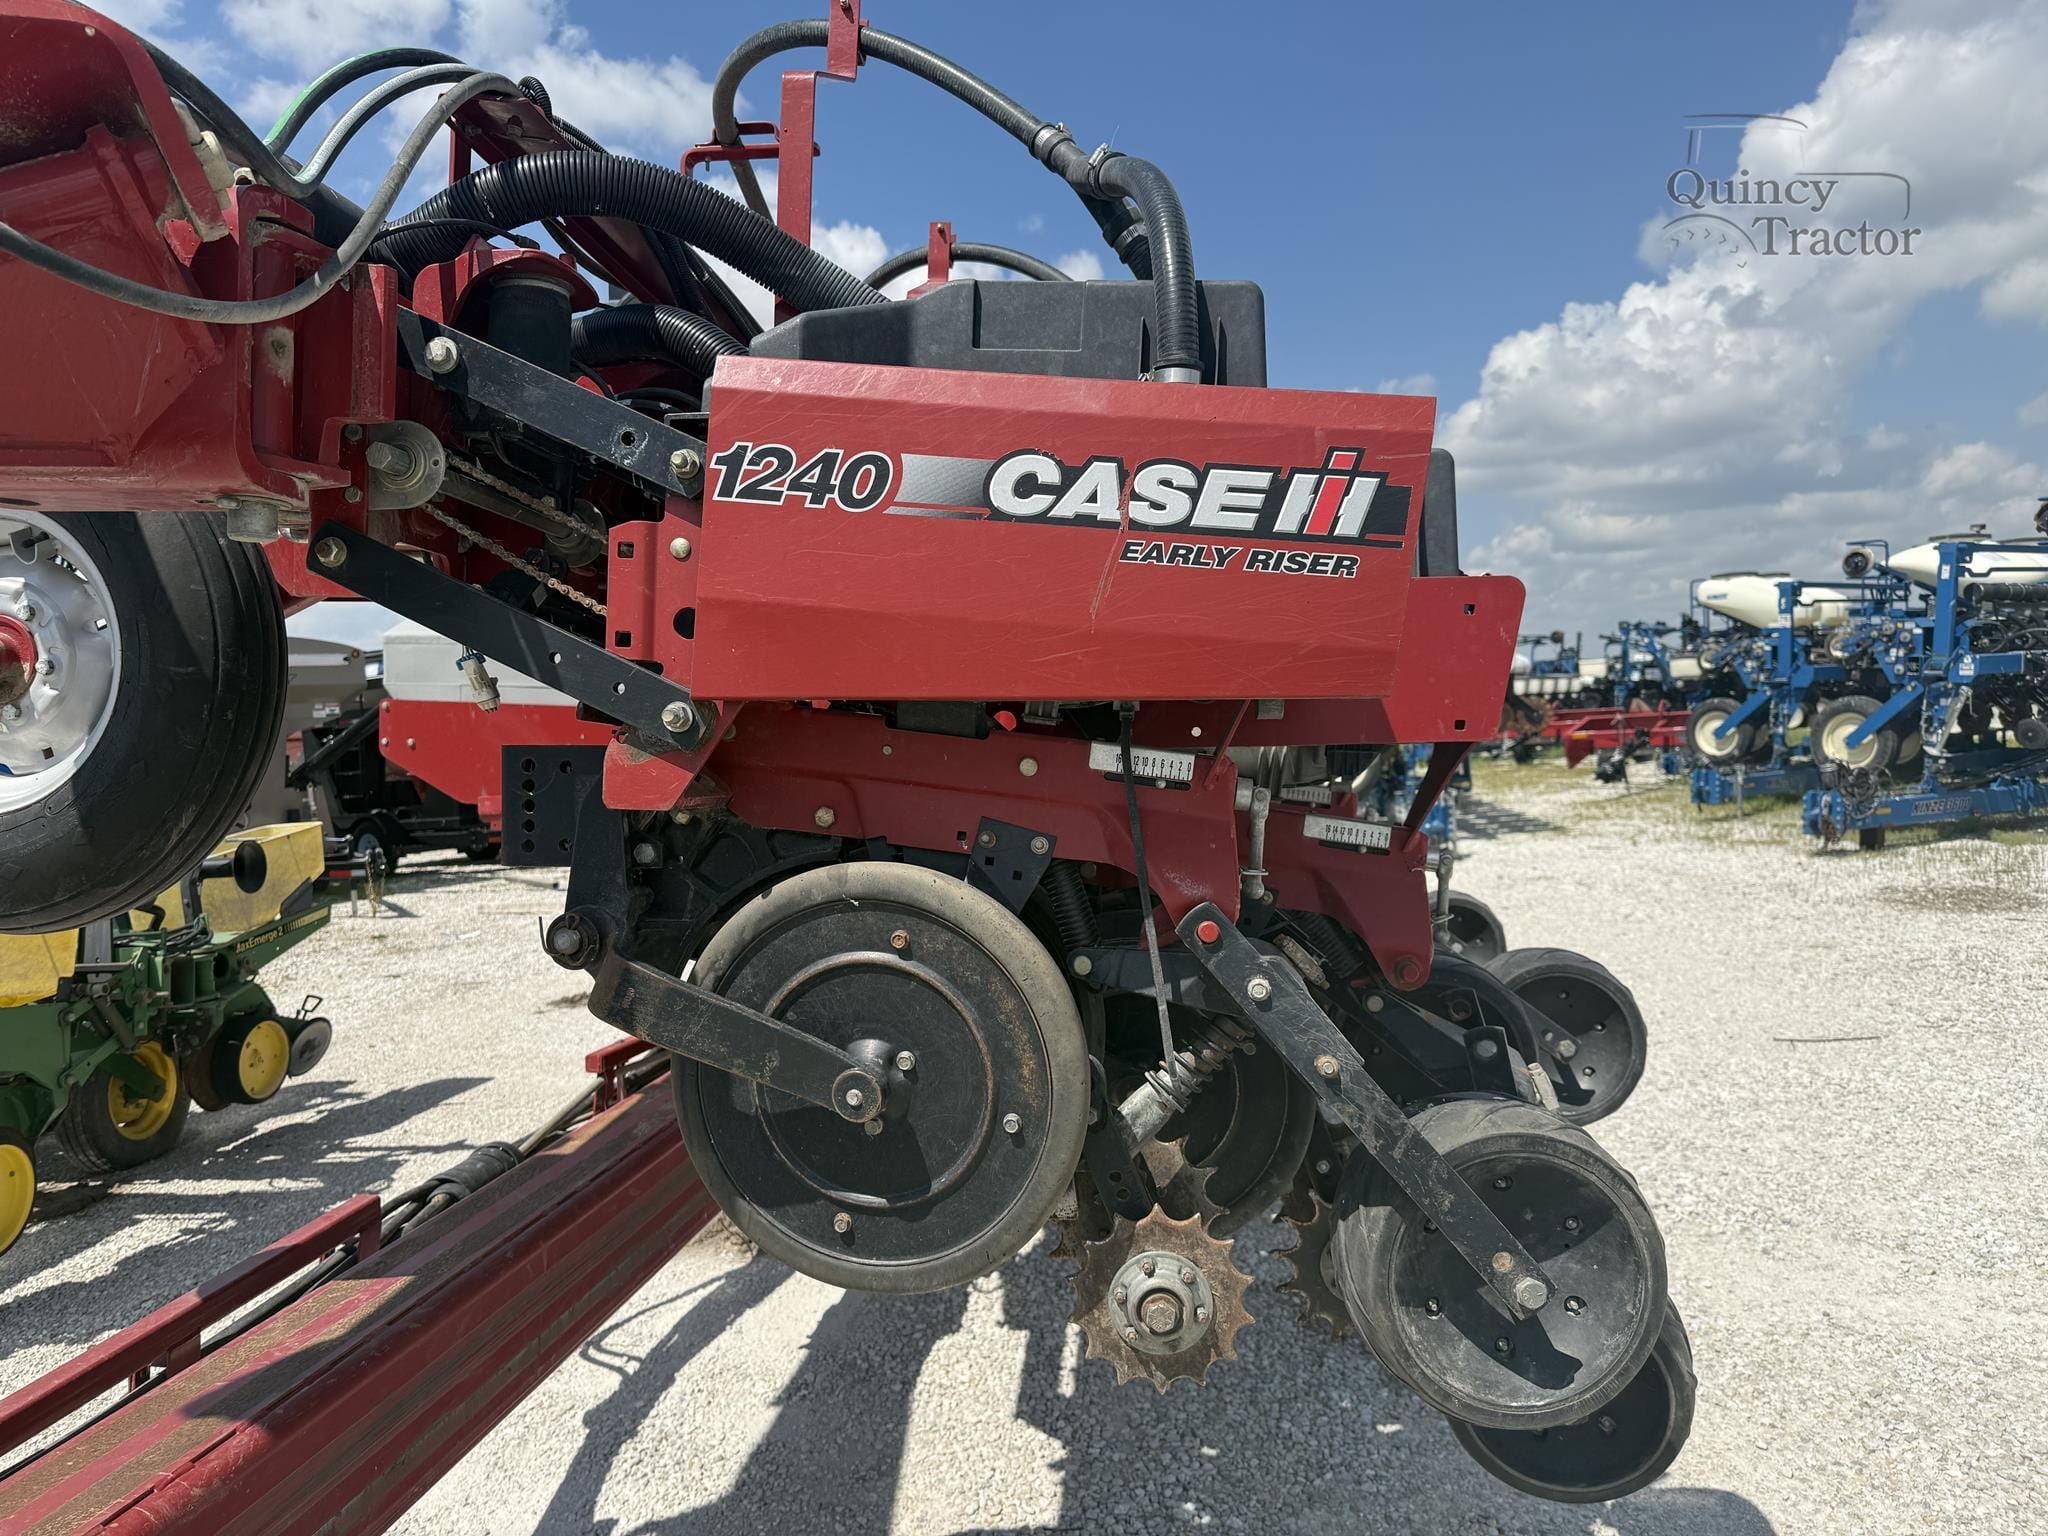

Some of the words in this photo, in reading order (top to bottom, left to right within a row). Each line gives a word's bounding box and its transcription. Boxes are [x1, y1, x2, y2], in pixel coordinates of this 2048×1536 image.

[709, 441, 894, 513] 1240
[988, 453, 1274, 532] CASE
[1118, 541, 1244, 570] EARLY
[1243, 548, 1361, 578] RISER
[1133, 755, 1140, 767] 12
[1142, 756, 1149, 768] 10
[1151, 758, 1156, 769] 8
[1161, 759, 1166, 770] 6
[1169, 760, 1174, 770] 4
[1178, 761, 1183, 772] 2
[277, 926, 284, 937] 2
